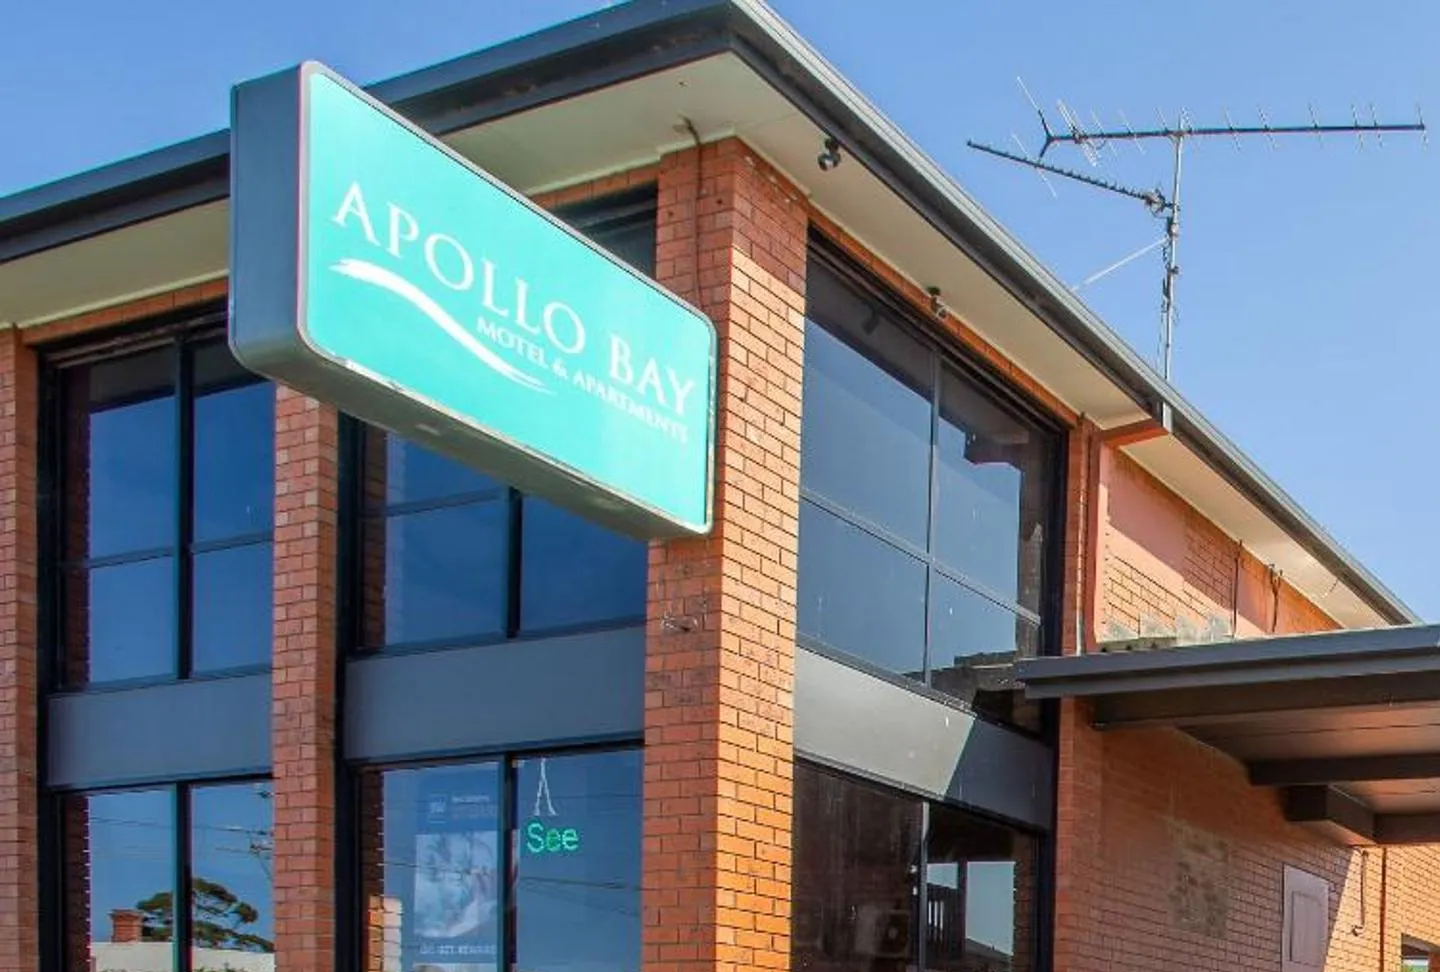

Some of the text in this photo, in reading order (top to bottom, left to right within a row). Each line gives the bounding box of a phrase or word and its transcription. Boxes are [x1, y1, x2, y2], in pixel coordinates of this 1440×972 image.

[331, 181, 695, 415] APOLLO BAY
[477, 316, 687, 443] MOTEL & APARTMENTS
[527, 823, 579, 852] See
